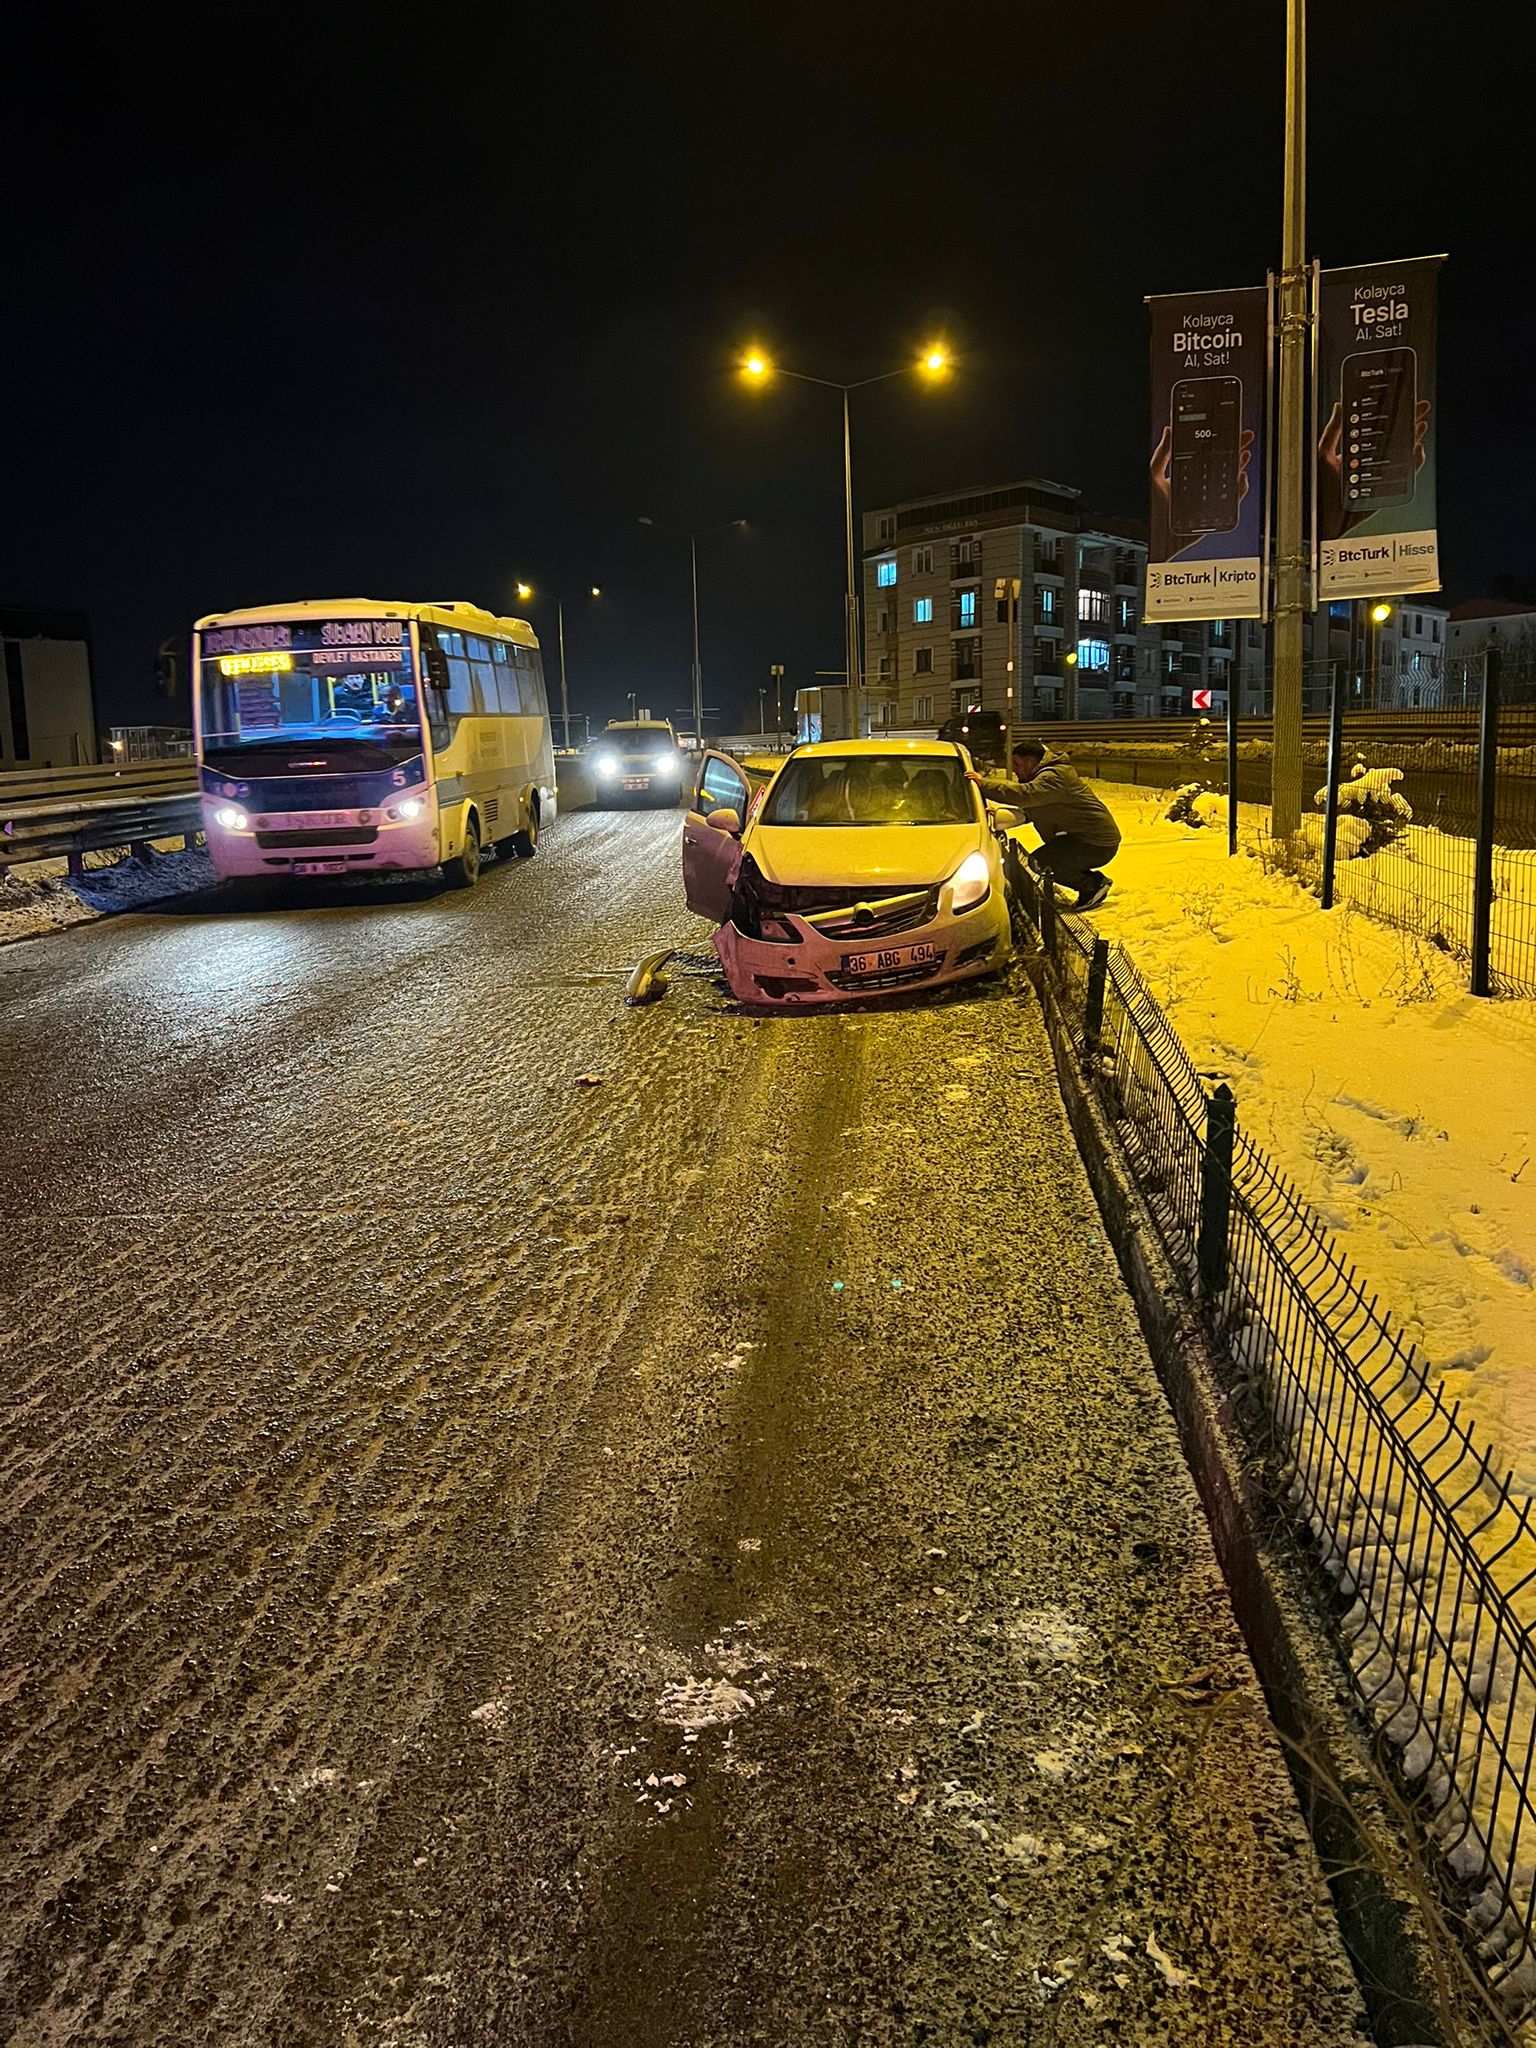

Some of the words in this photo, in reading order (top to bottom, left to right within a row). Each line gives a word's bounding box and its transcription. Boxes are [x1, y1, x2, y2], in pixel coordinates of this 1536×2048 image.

[1354, 284, 1405, 301] Kolayca
[1350, 299, 1409, 325] Tesla
[1183, 313, 1234, 329] Kolayca
[1173, 328, 1242, 352] Bitcoin
[1356, 327, 1372, 341] Al,
[1375, 322, 1402, 338] Sat!
[1184, 354, 1200, 368] Al,
[1203, 351, 1230, 366] Sat!
[1194, 429, 1212, 439] 500
[1339, 546, 1389, 562] BtcTurk
[1399, 544, 1435, 557] Hisse
[1164, 571, 1211, 585] BtcTurk
[1219, 570, 1256, 583] Kripto
[391, 769, 407, 786] 5
[850, 956, 867, 972] 36
[877, 951, 901, 969] ABG
[911, 945, 933, 962] 494
